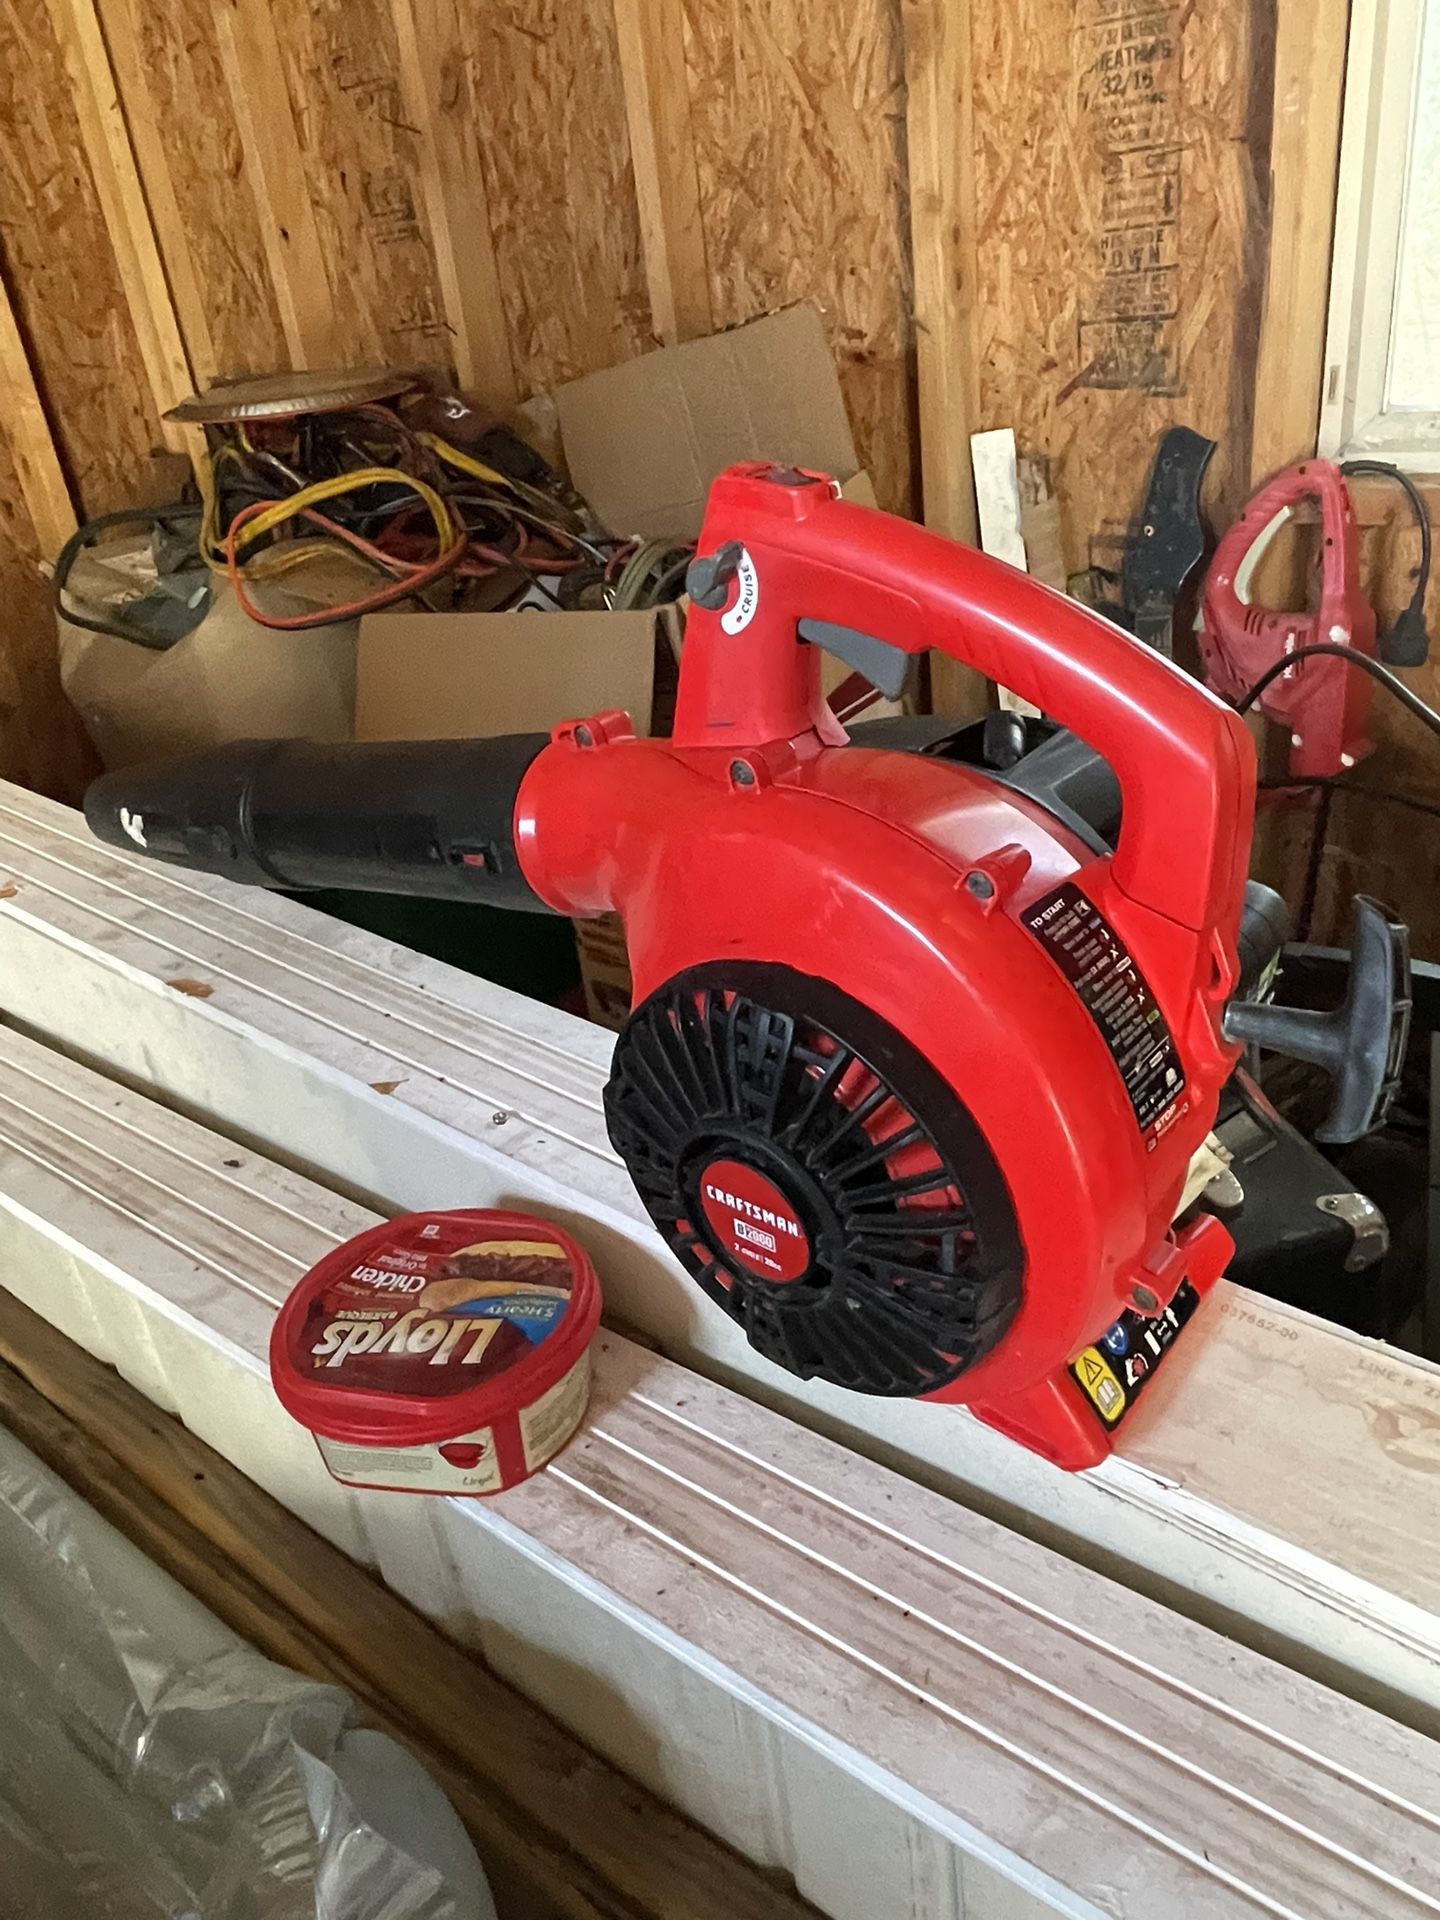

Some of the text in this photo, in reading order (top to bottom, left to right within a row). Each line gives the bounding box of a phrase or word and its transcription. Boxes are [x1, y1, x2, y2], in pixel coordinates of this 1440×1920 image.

[741, 564, 753, 614] CRUISE
[1030, 914, 1043, 929] TO
[1041, 898, 1066, 921] START
[1153, 1103, 1177, 1131] STOP
[706, 1184, 799, 1237] CRAFTSMAN
[351, 1265, 426, 1294] Chicken
[1357, 1358, 1398, 1382] LINE
